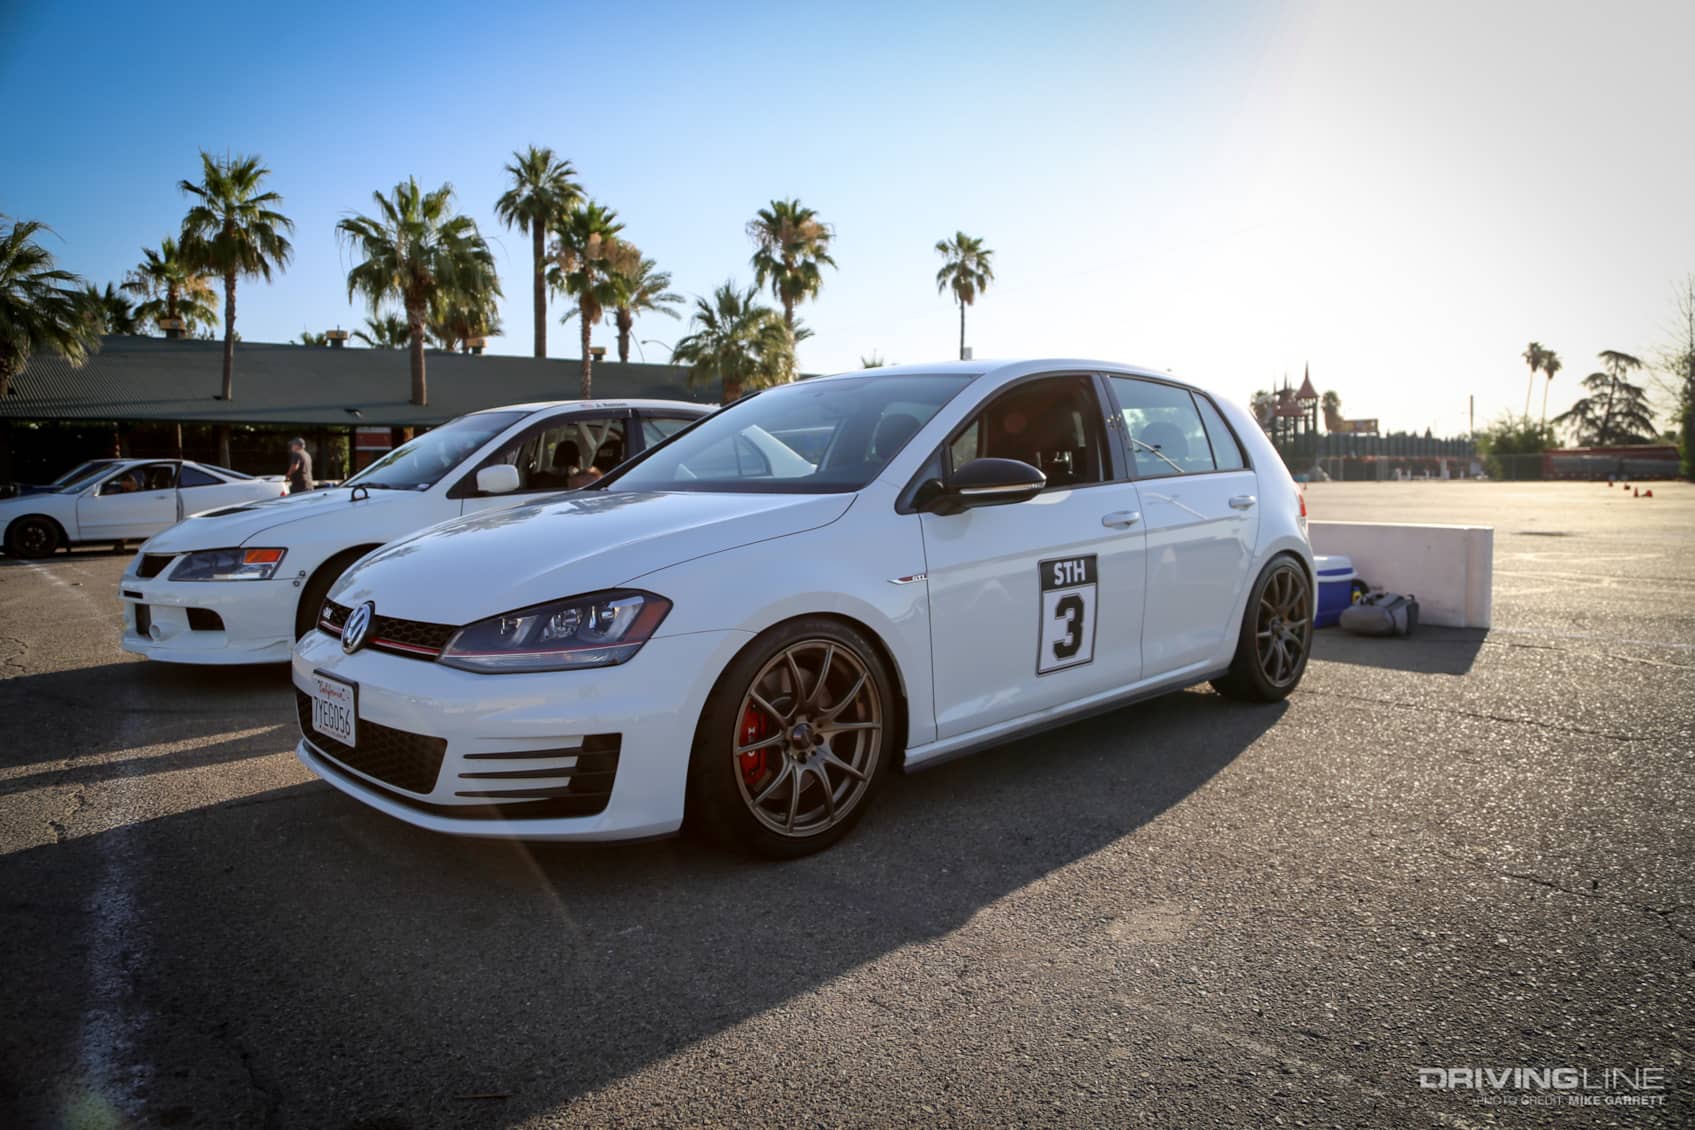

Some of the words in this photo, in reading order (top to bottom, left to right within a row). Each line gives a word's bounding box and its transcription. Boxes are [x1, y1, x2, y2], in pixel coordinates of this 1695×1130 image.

[1053, 560, 1086, 586] STH
[1053, 593, 1084, 660] 3
[314, 696, 351, 735] 7YEG056
